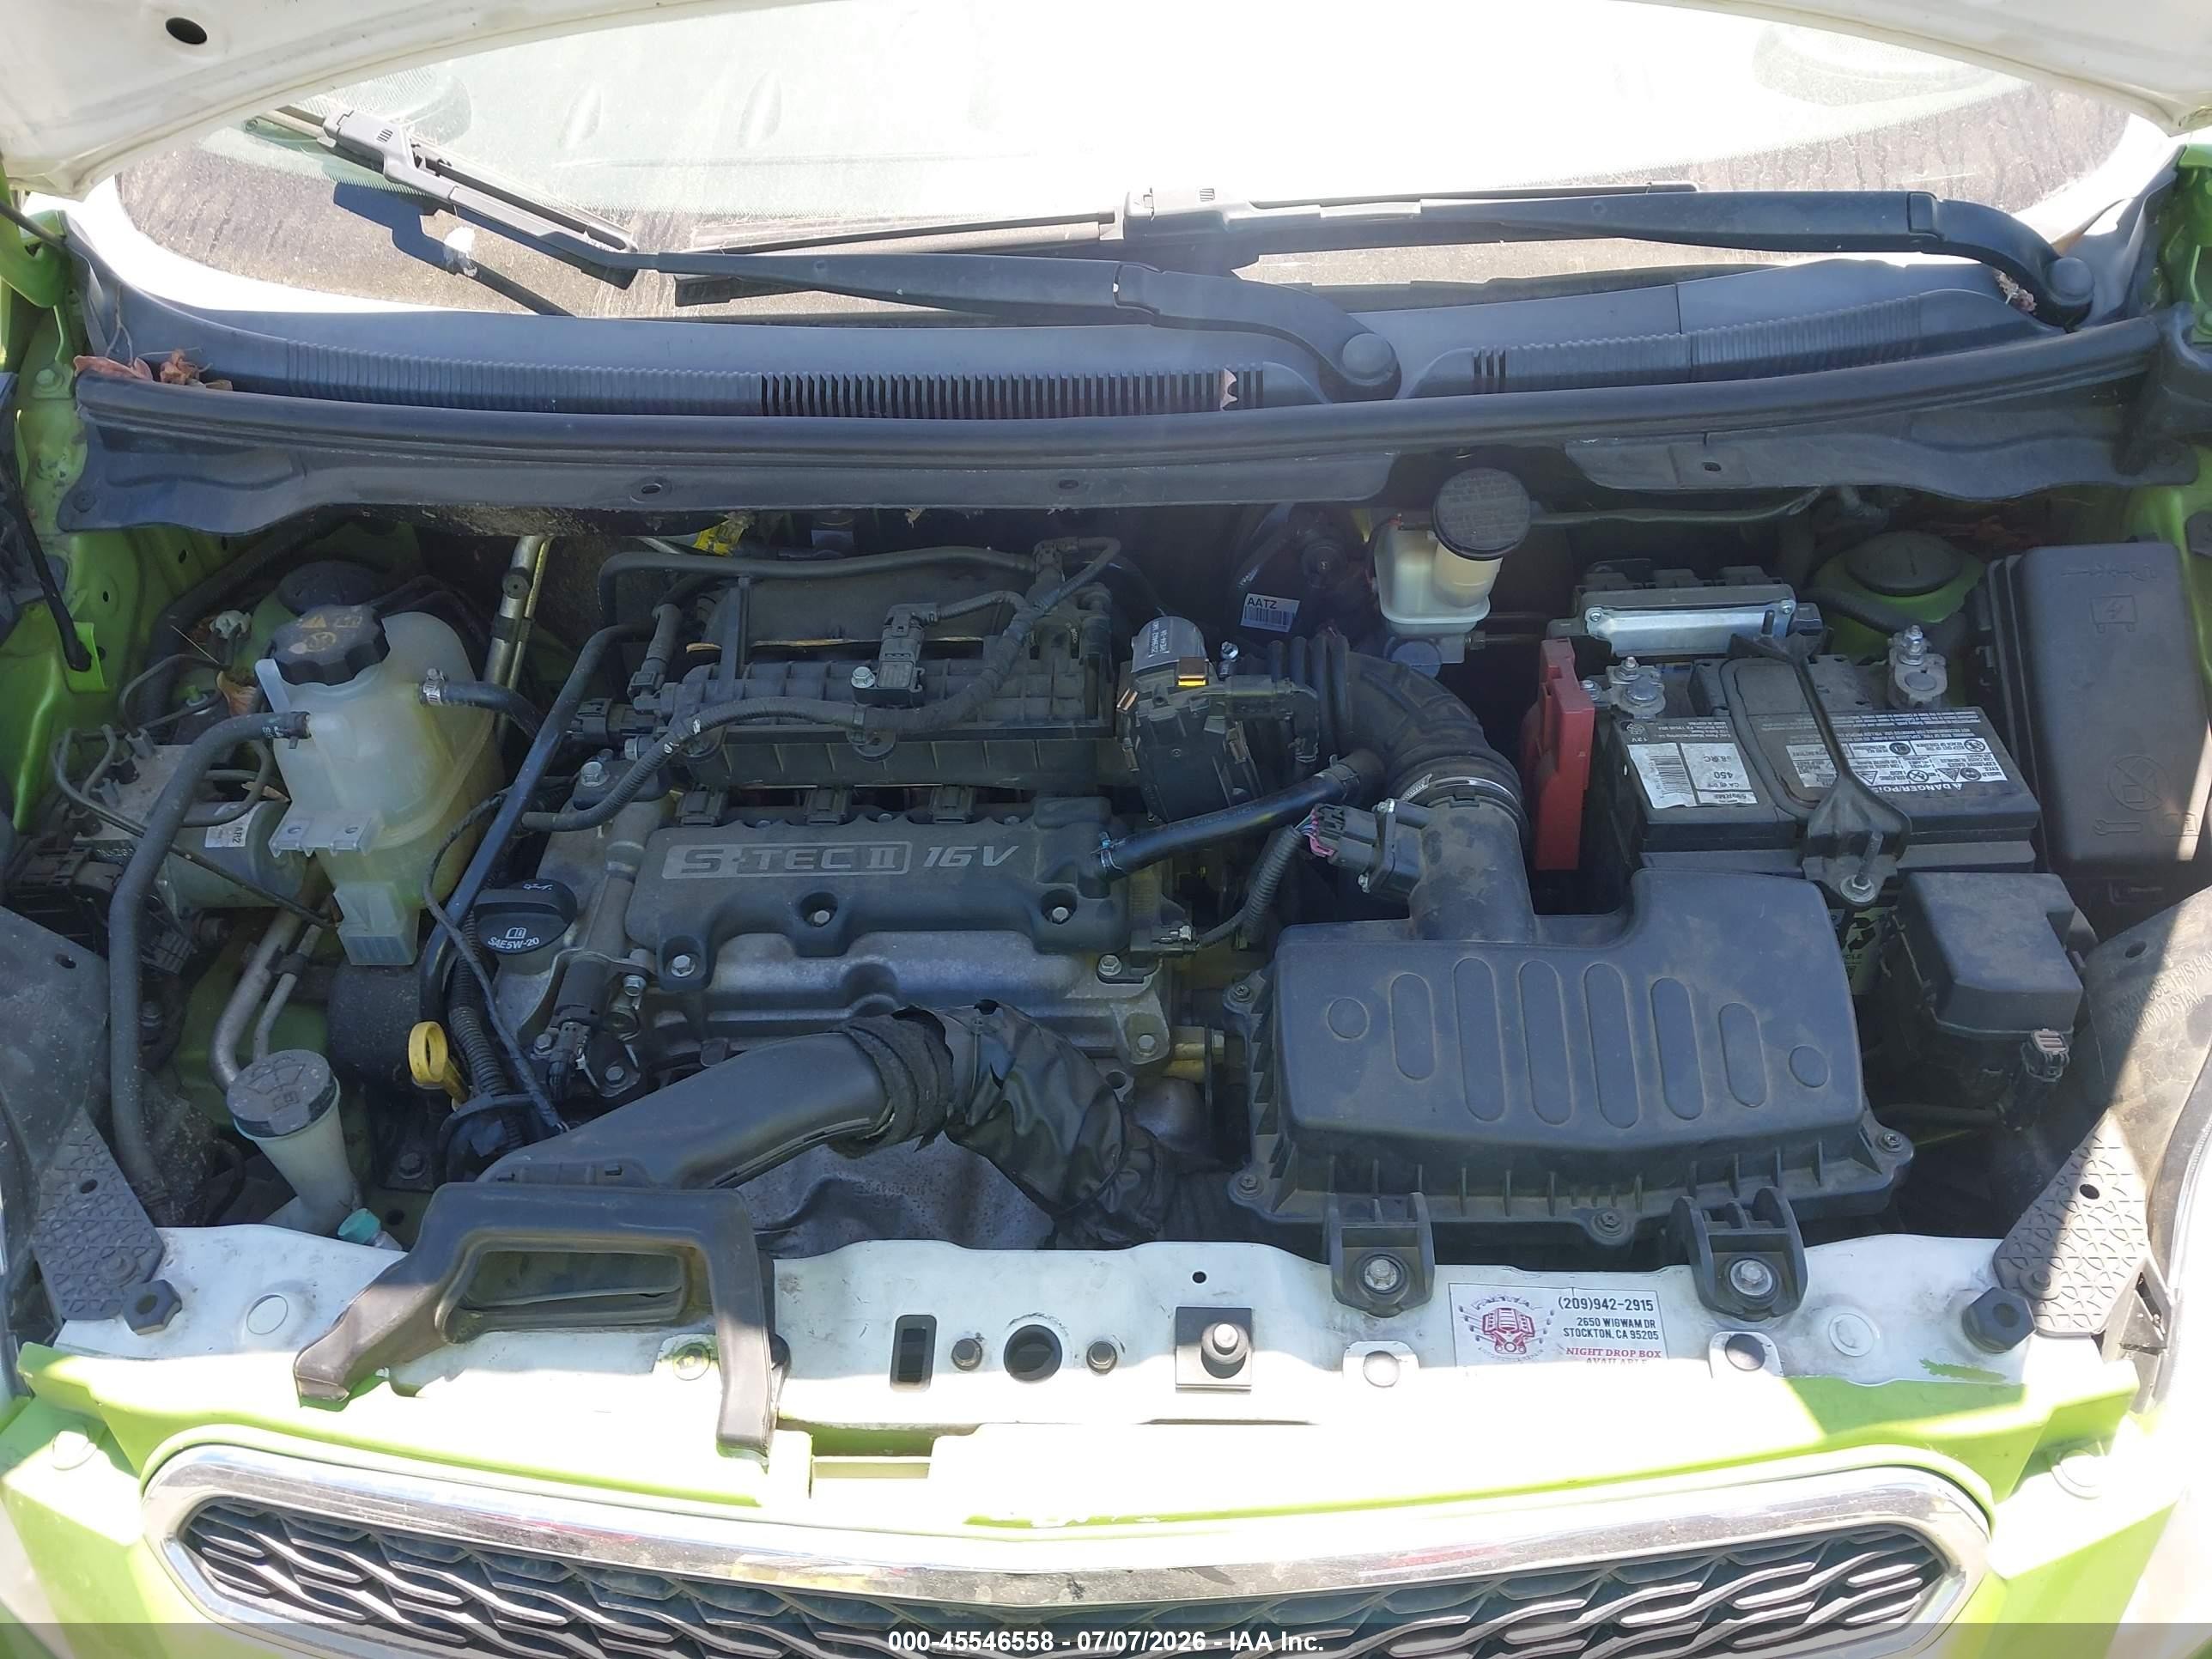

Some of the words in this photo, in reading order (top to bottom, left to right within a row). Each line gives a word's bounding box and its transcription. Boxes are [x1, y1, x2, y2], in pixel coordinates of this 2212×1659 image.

[1247, 597, 1277, 610] AATZ
[1713, 770, 1734, 779] 450
[233, 826, 244, 844] AR2
[922, 845, 1019, 868] 16V
[1558, 1296, 1655, 1312] (209)942-2915
[1576, 1317, 1601, 1327] 2650
[1602, 1318, 1643, 1328] WIGWAM
[1644, 1319, 1656, 1328] DR
[1615, 1329, 1629, 1340] CA
[1630, 1330, 1659, 1340] 95205
[1565, 1347, 1604, 1358] NIGHT
[1605, 1348, 1637, 1358] DROP
[1638, 1350, 1662, 1358] BOX
